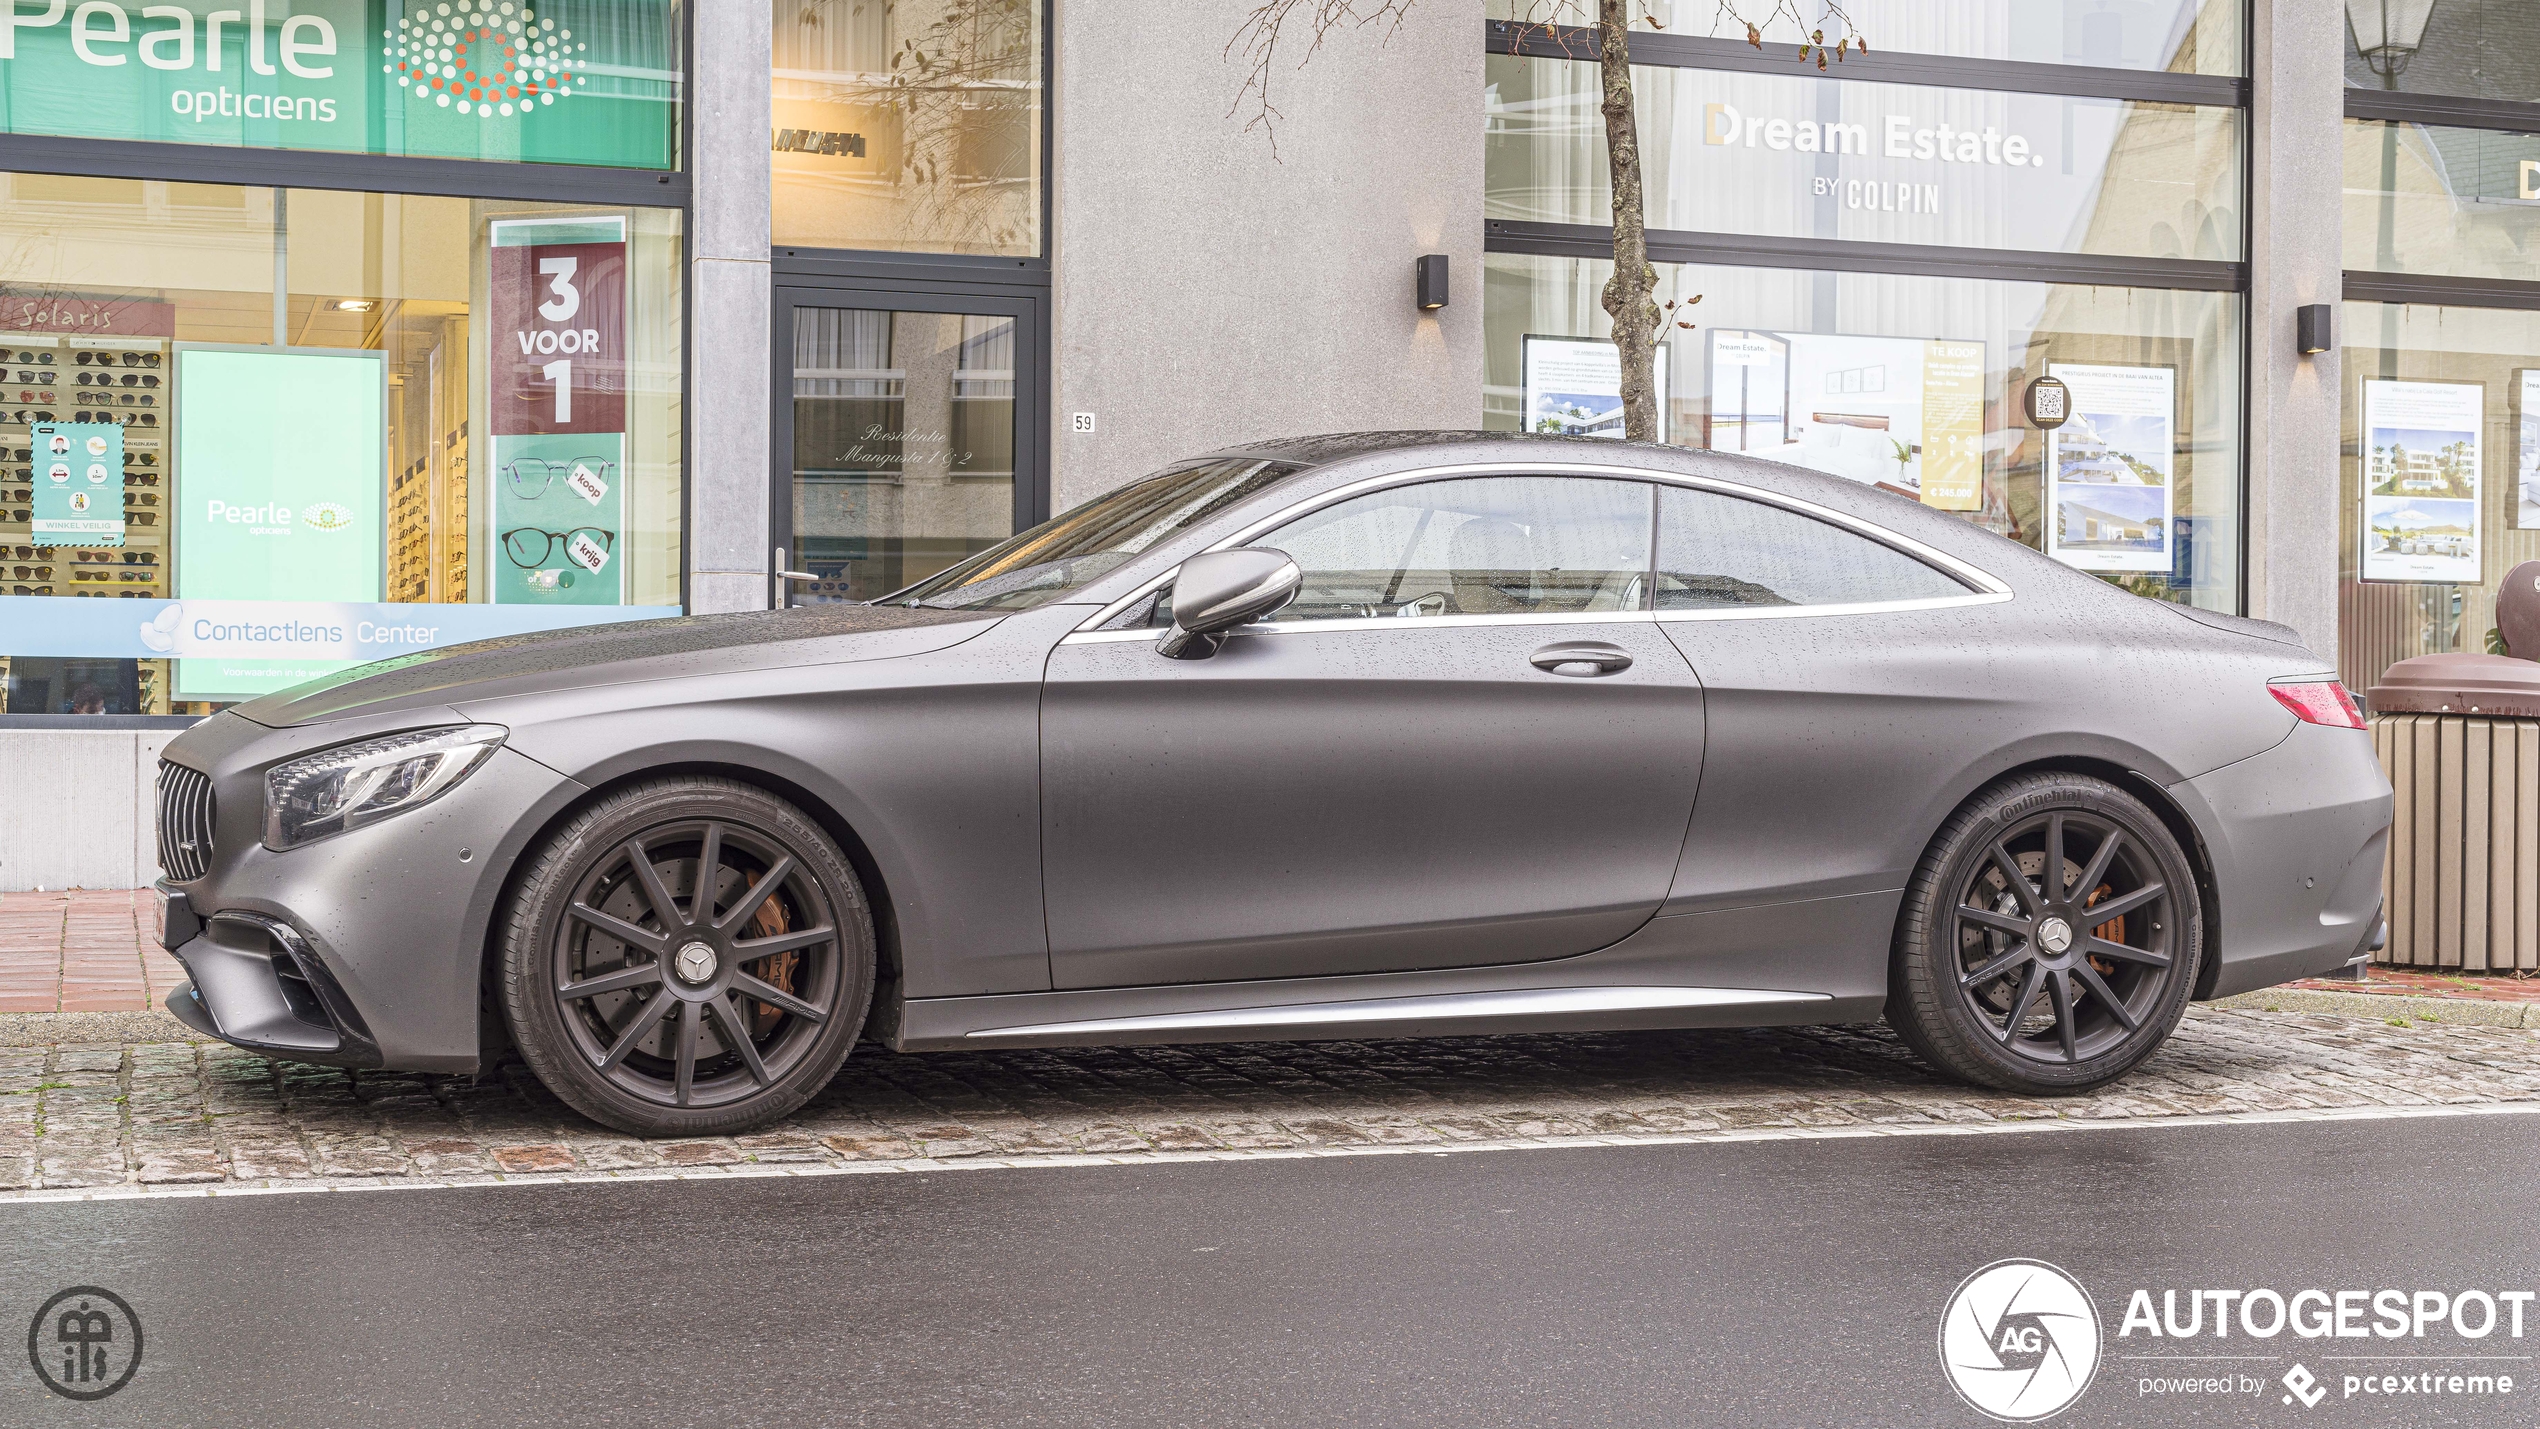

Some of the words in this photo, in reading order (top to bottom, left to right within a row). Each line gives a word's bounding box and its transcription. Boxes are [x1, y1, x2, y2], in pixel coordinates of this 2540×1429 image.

[0, 0, 337, 79] Pearle
[171, 86, 336, 122] opticiens
[1706, 103, 1868, 155] Dream
[1884, 115, 2044, 167] Estate.
[1815, 177, 1839, 196] BY
[1848, 180, 1939, 214] COLPIN
[538, 257, 580, 322] 3
[20, 302, 111, 329] Solaris
[518, 329, 600, 355] VOOR
[1932, 346, 1945, 356] TE
[1947, 347, 1977, 358] KOOP
[542, 359, 571, 423] 1
[860, 424, 947, 443] Residentie
[1076, 416, 1091, 430] 59
[835, 444, 923, 468] Mangusta
[958, 451, 973, 465] 2
[577, 473, 601, 498] koop
[1939, 488, 1973, 498] 245.000
[208, 499, 292, 525] Pearle
[249, 526, 292, 536] opticiens
[579, 543, 601, 568] krijg
[194, 619, 343, 642] Contactlens
[357, 621, 440, 644] Center
[223, 667, 282, 677] Voorwaarden
[285, 668, 293, 677] in
[294, 668, 307, 677] de
[1999, 788, 2082, 822] Continental
[782, 817, 827, 858] 255/40
[840, 881, 853, 900] 20
[527, 857, 573, 965] ContiSportContact
[2169, 924, 2196, 1019] ContiSportContact
